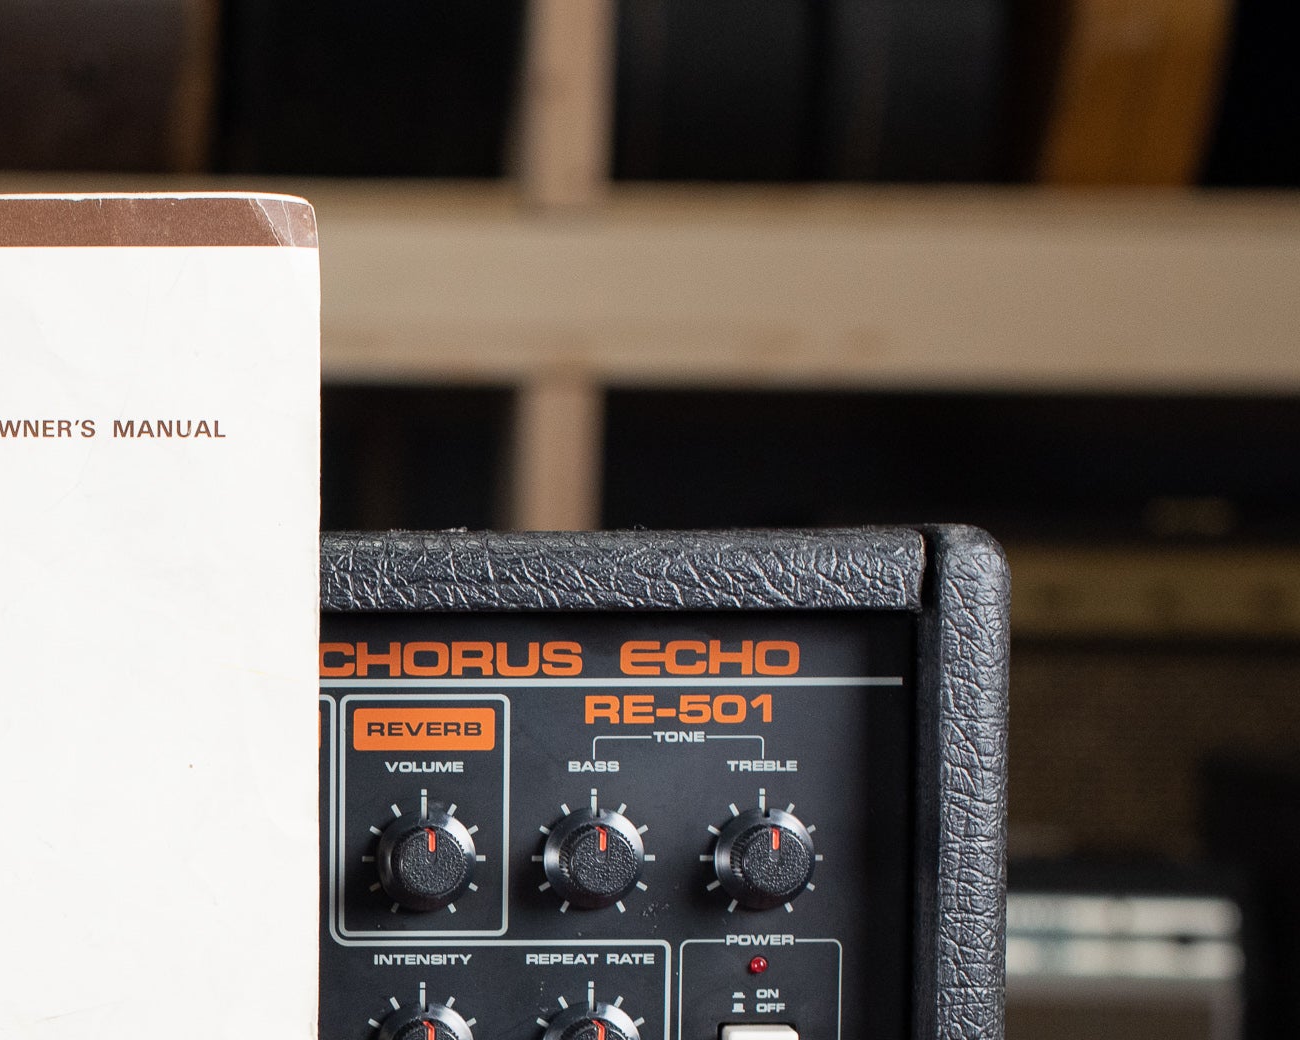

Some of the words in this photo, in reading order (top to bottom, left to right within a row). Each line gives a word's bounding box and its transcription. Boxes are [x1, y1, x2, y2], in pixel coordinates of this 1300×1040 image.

[113, 419, 226, 438] MANUAL
[319, 641, 583, 677] CHORUS
[619, 639, 800, 676] ECHO
[584, 693, 773, 725] RE-501
[365, 721, 484, 738] REVERB
[652, 730, 706, 743] TONE
[384, 761, 464, 773] VOLUME
[568, 760, 620, 773] BASS
[726, 760, 798, 772] TREBLE
[725, 934, 795, 946] POWER
[373, 953, 473, 966] INTENSITY
[525, 953, 599, 965] REPEAT
[606, 953, 655, 965] RATE
[755, 988, 780, 999] ON
[755, 1002, 786, 1013] OFF
